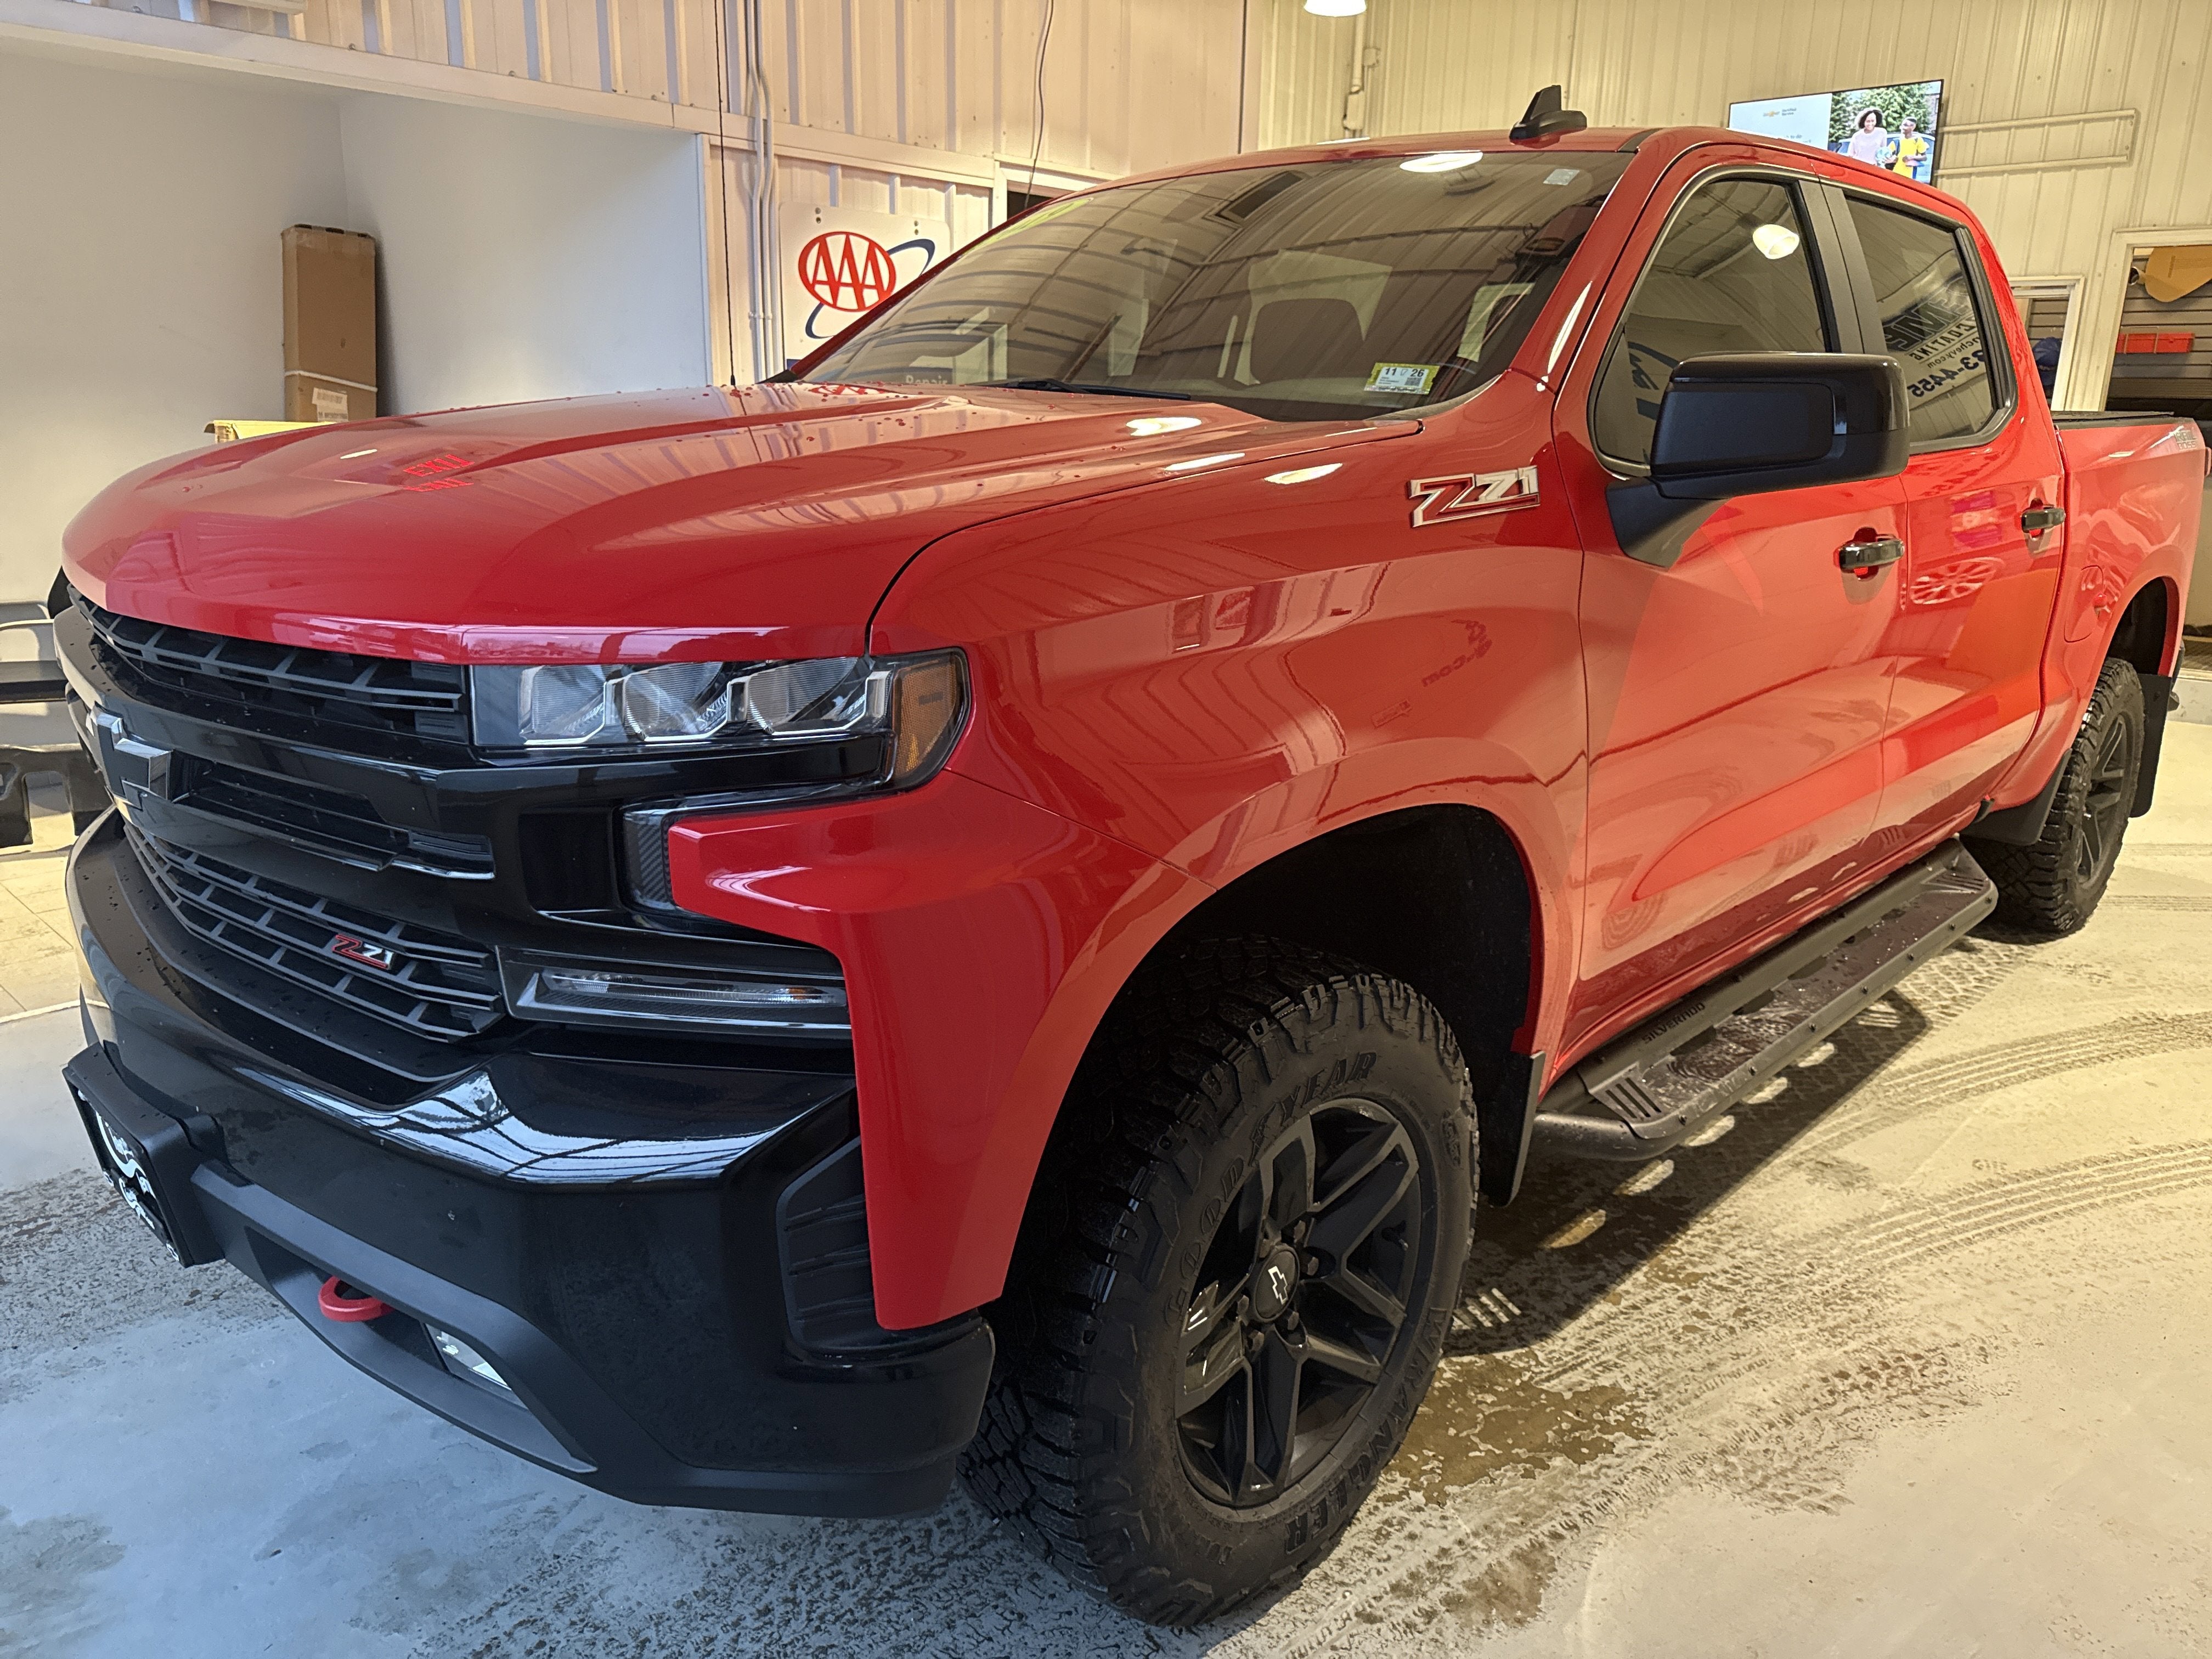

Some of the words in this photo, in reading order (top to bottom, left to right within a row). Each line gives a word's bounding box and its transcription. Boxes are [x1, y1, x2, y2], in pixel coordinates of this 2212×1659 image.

[803, 232, 895, 312] AAA
[1385, 368, 1397, 376] 11
[1410, 368, 1425, 377] 26
[1407, 465, 1541, 528] Z71
[331, 934, 395, 970] Z71
